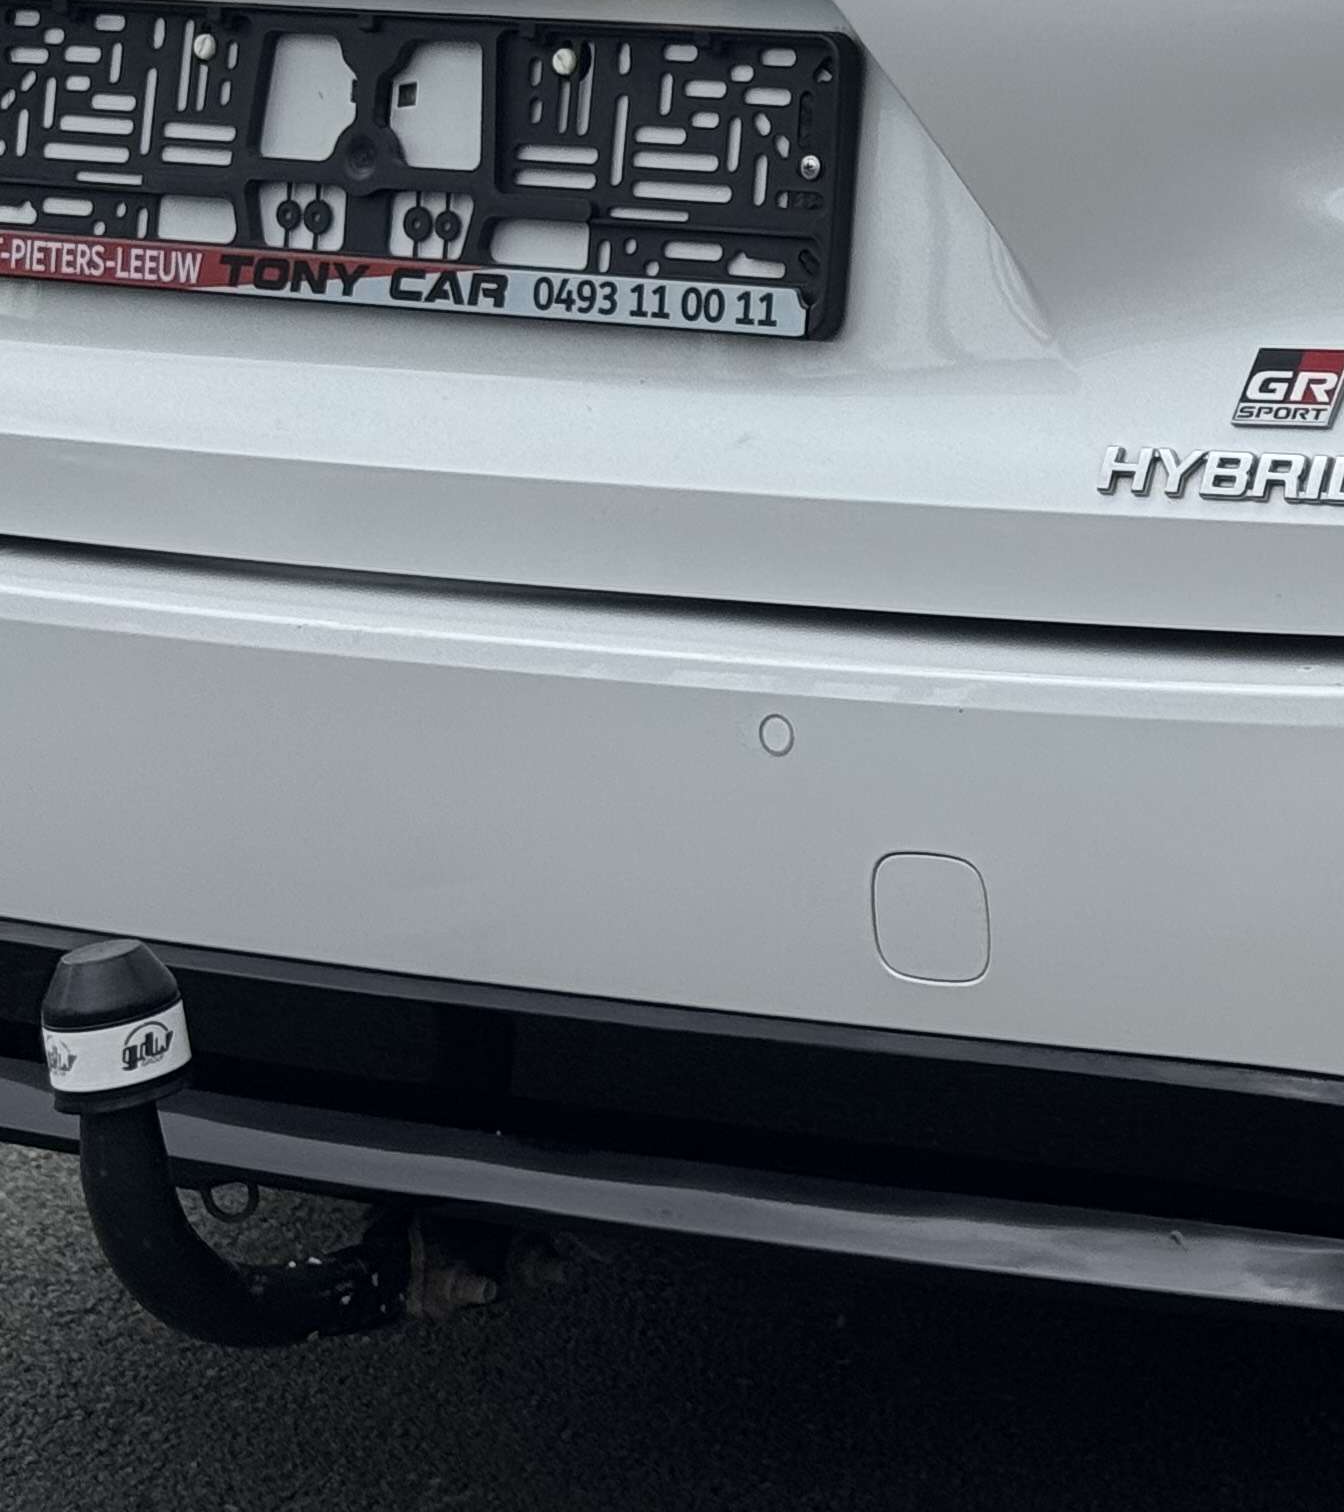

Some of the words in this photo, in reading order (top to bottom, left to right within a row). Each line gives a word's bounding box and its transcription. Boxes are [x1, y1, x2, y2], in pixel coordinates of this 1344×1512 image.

[0, 236, 202, 284] -PIETERS-LEEUW
[220, 254, 371, 297] TONY
[388, 268, 509, 308] CAR
[533, 276, 618, 315] 0493
[629, 285, 670, 319] 11
[681, 288, 726, 323] 00
[735, 291, 778, 327] 11
[1245, 370, 1339, 403] GR
[1236, 405, 1329, 422] SPORT
